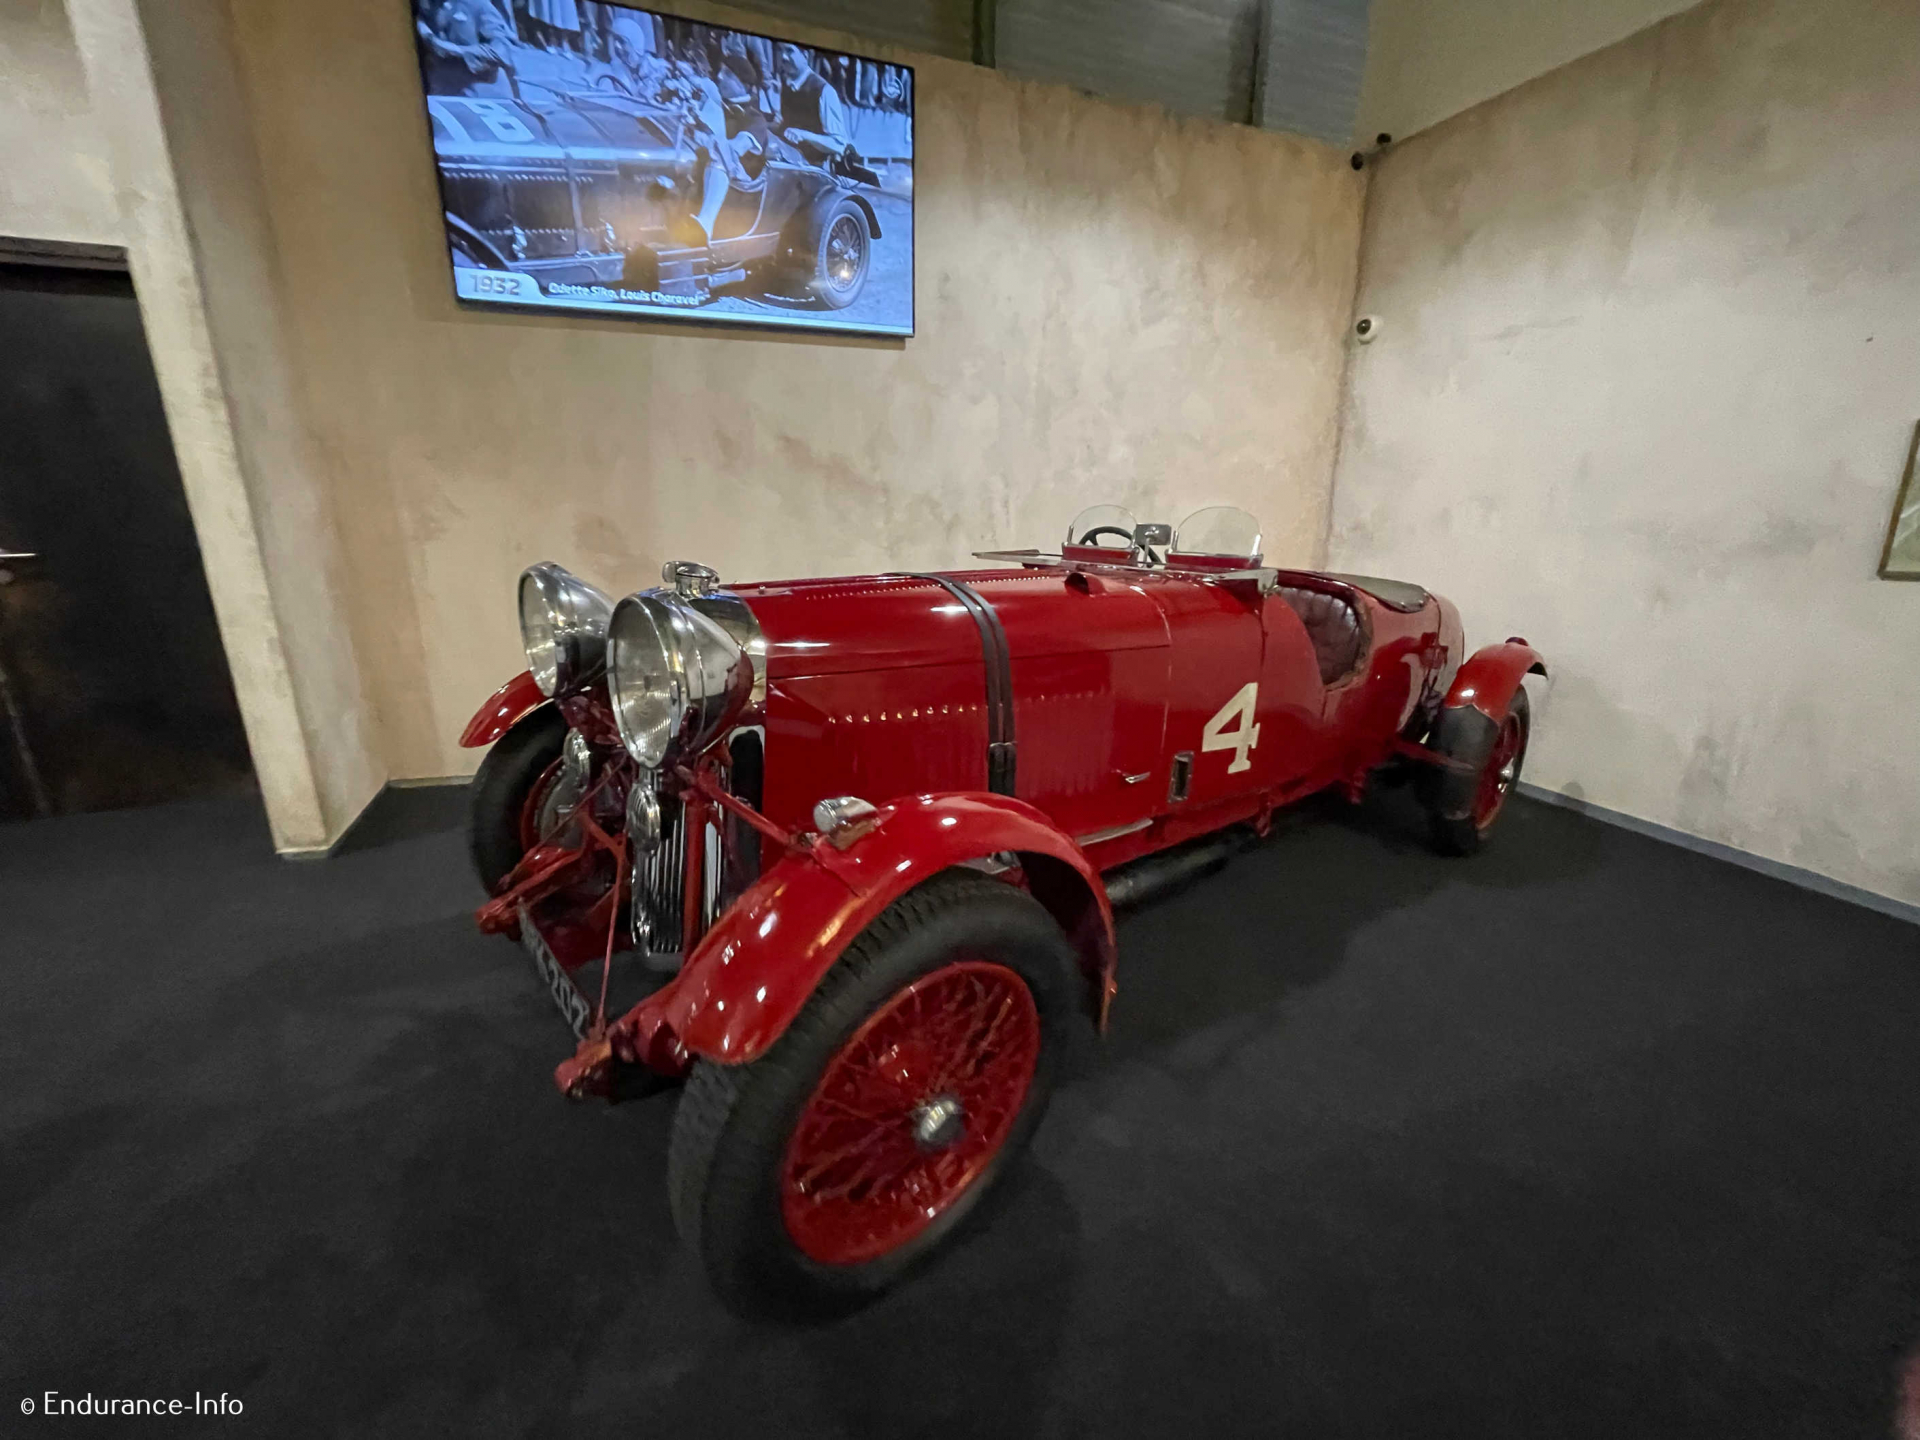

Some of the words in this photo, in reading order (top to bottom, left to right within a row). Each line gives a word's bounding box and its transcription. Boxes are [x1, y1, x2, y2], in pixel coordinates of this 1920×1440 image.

[469, 274, 521, 296] 1932
[548, 282, 591, 296] Odette
[620, 288, 651, 302] Louis
[1202, 682, 1260, 774] 4
